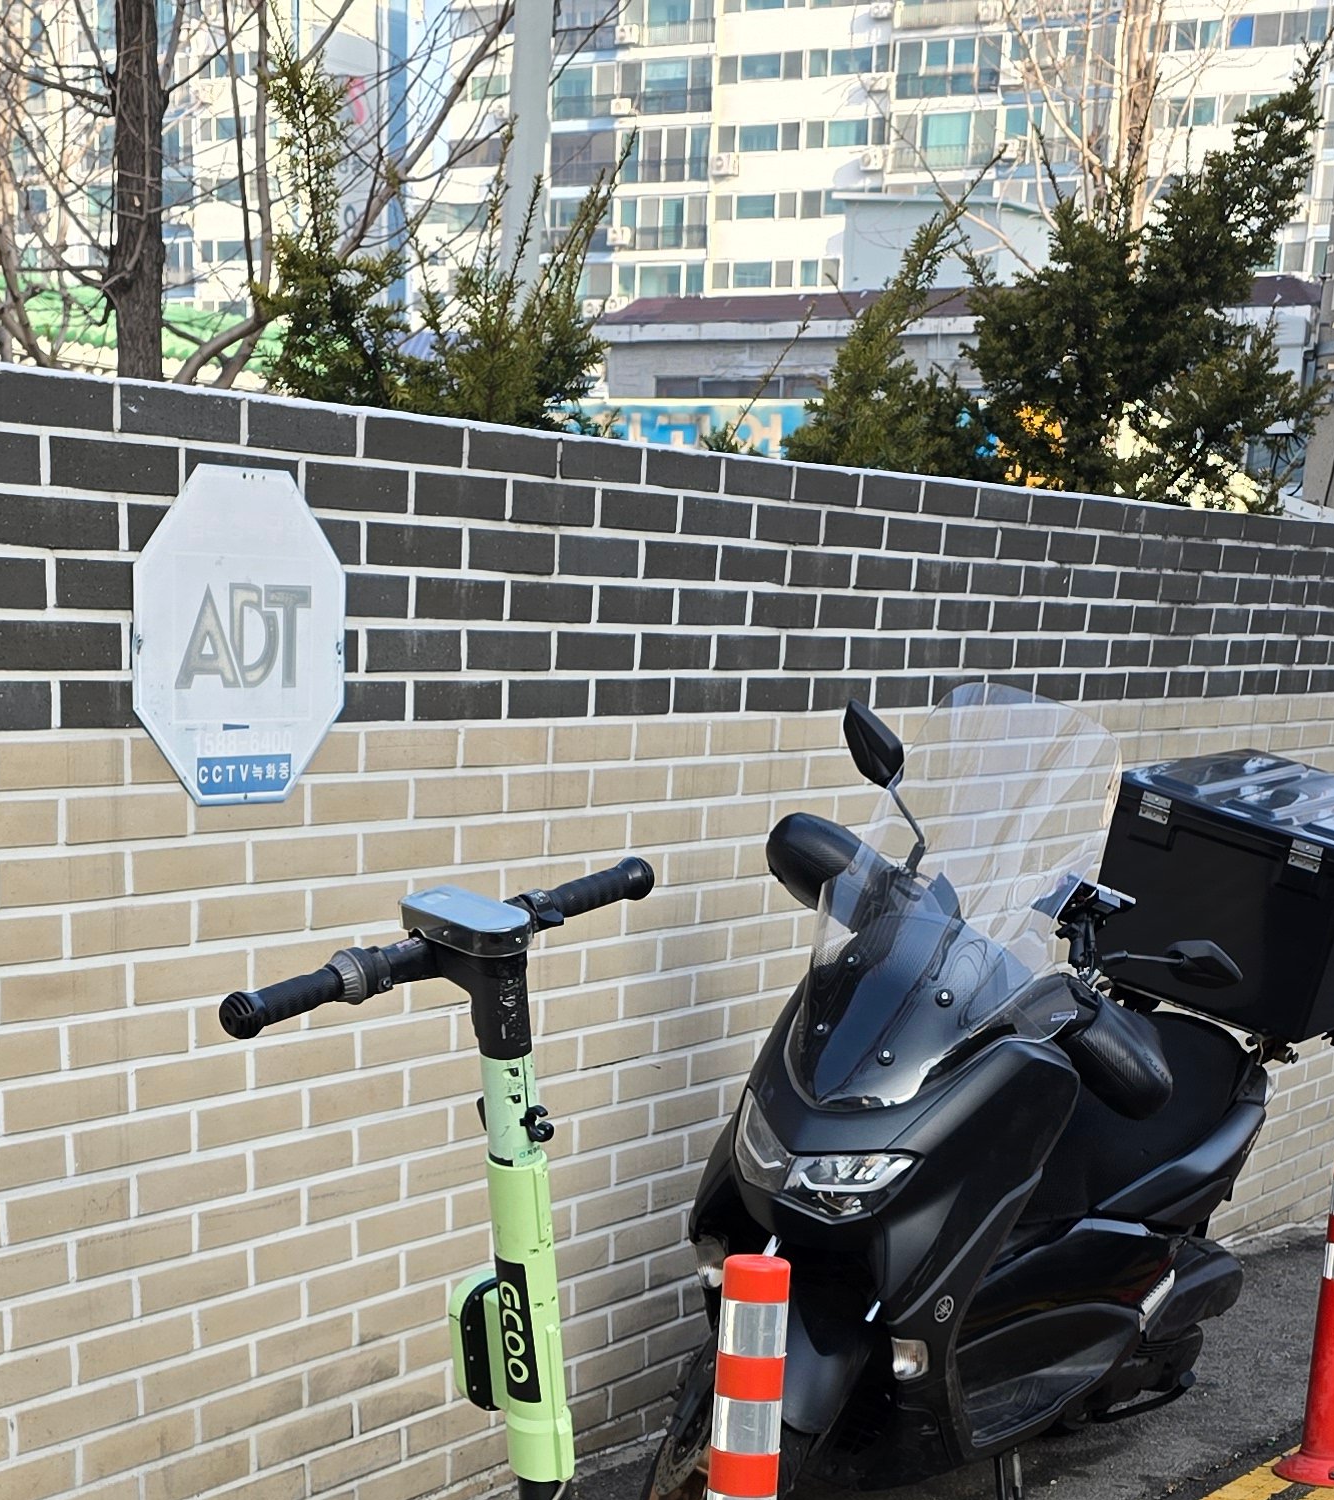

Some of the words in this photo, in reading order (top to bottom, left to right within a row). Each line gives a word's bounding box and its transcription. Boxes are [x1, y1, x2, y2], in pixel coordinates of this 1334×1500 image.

[175, 583, 311, 690] ADT
[198, 762, 290, 784] CCTV녹화중
[498, 1280, 529, 1385] GCOO
